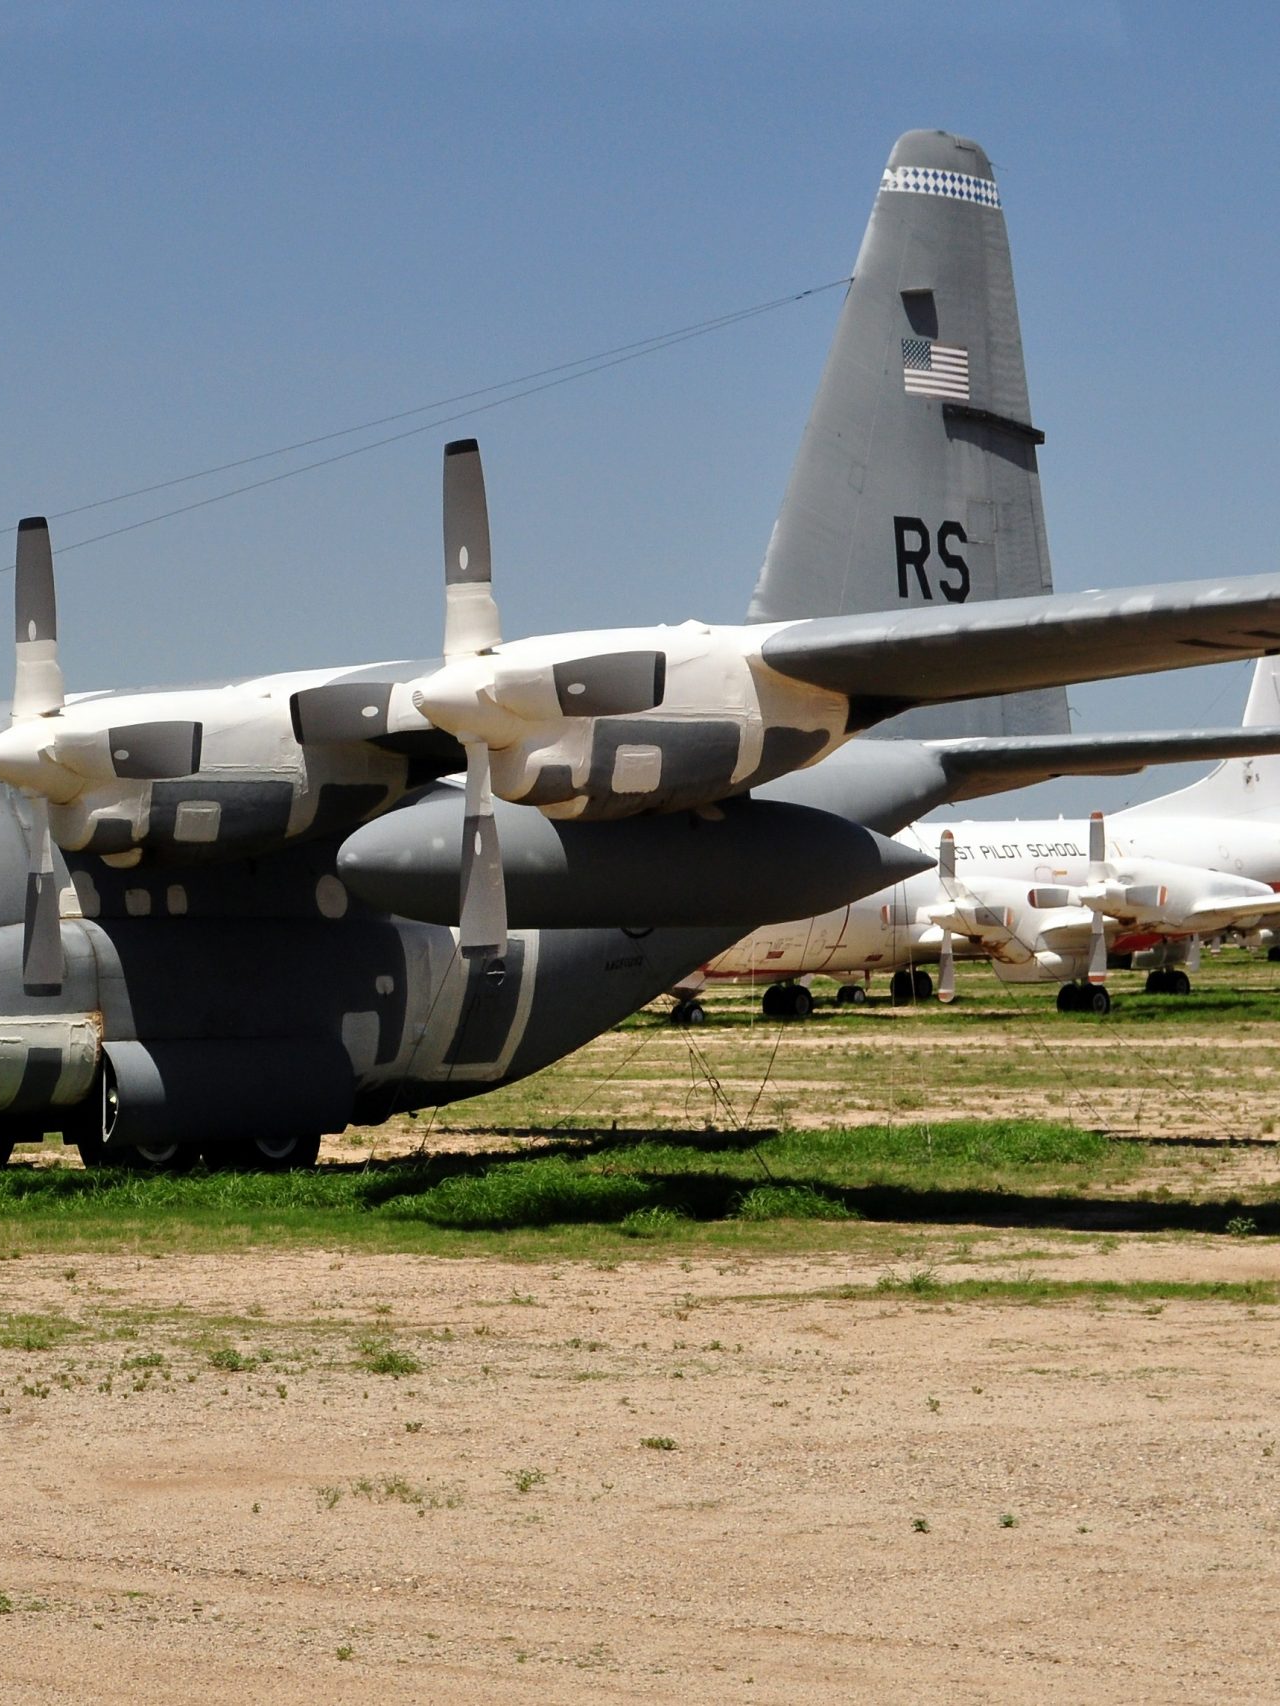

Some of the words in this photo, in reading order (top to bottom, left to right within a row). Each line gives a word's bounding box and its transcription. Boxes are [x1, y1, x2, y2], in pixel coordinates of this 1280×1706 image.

[894, 516, 970, 603] RS
[980, 843, 1022, 859] PILOT
[1027, 843, 1087, 858] SCHOOL
